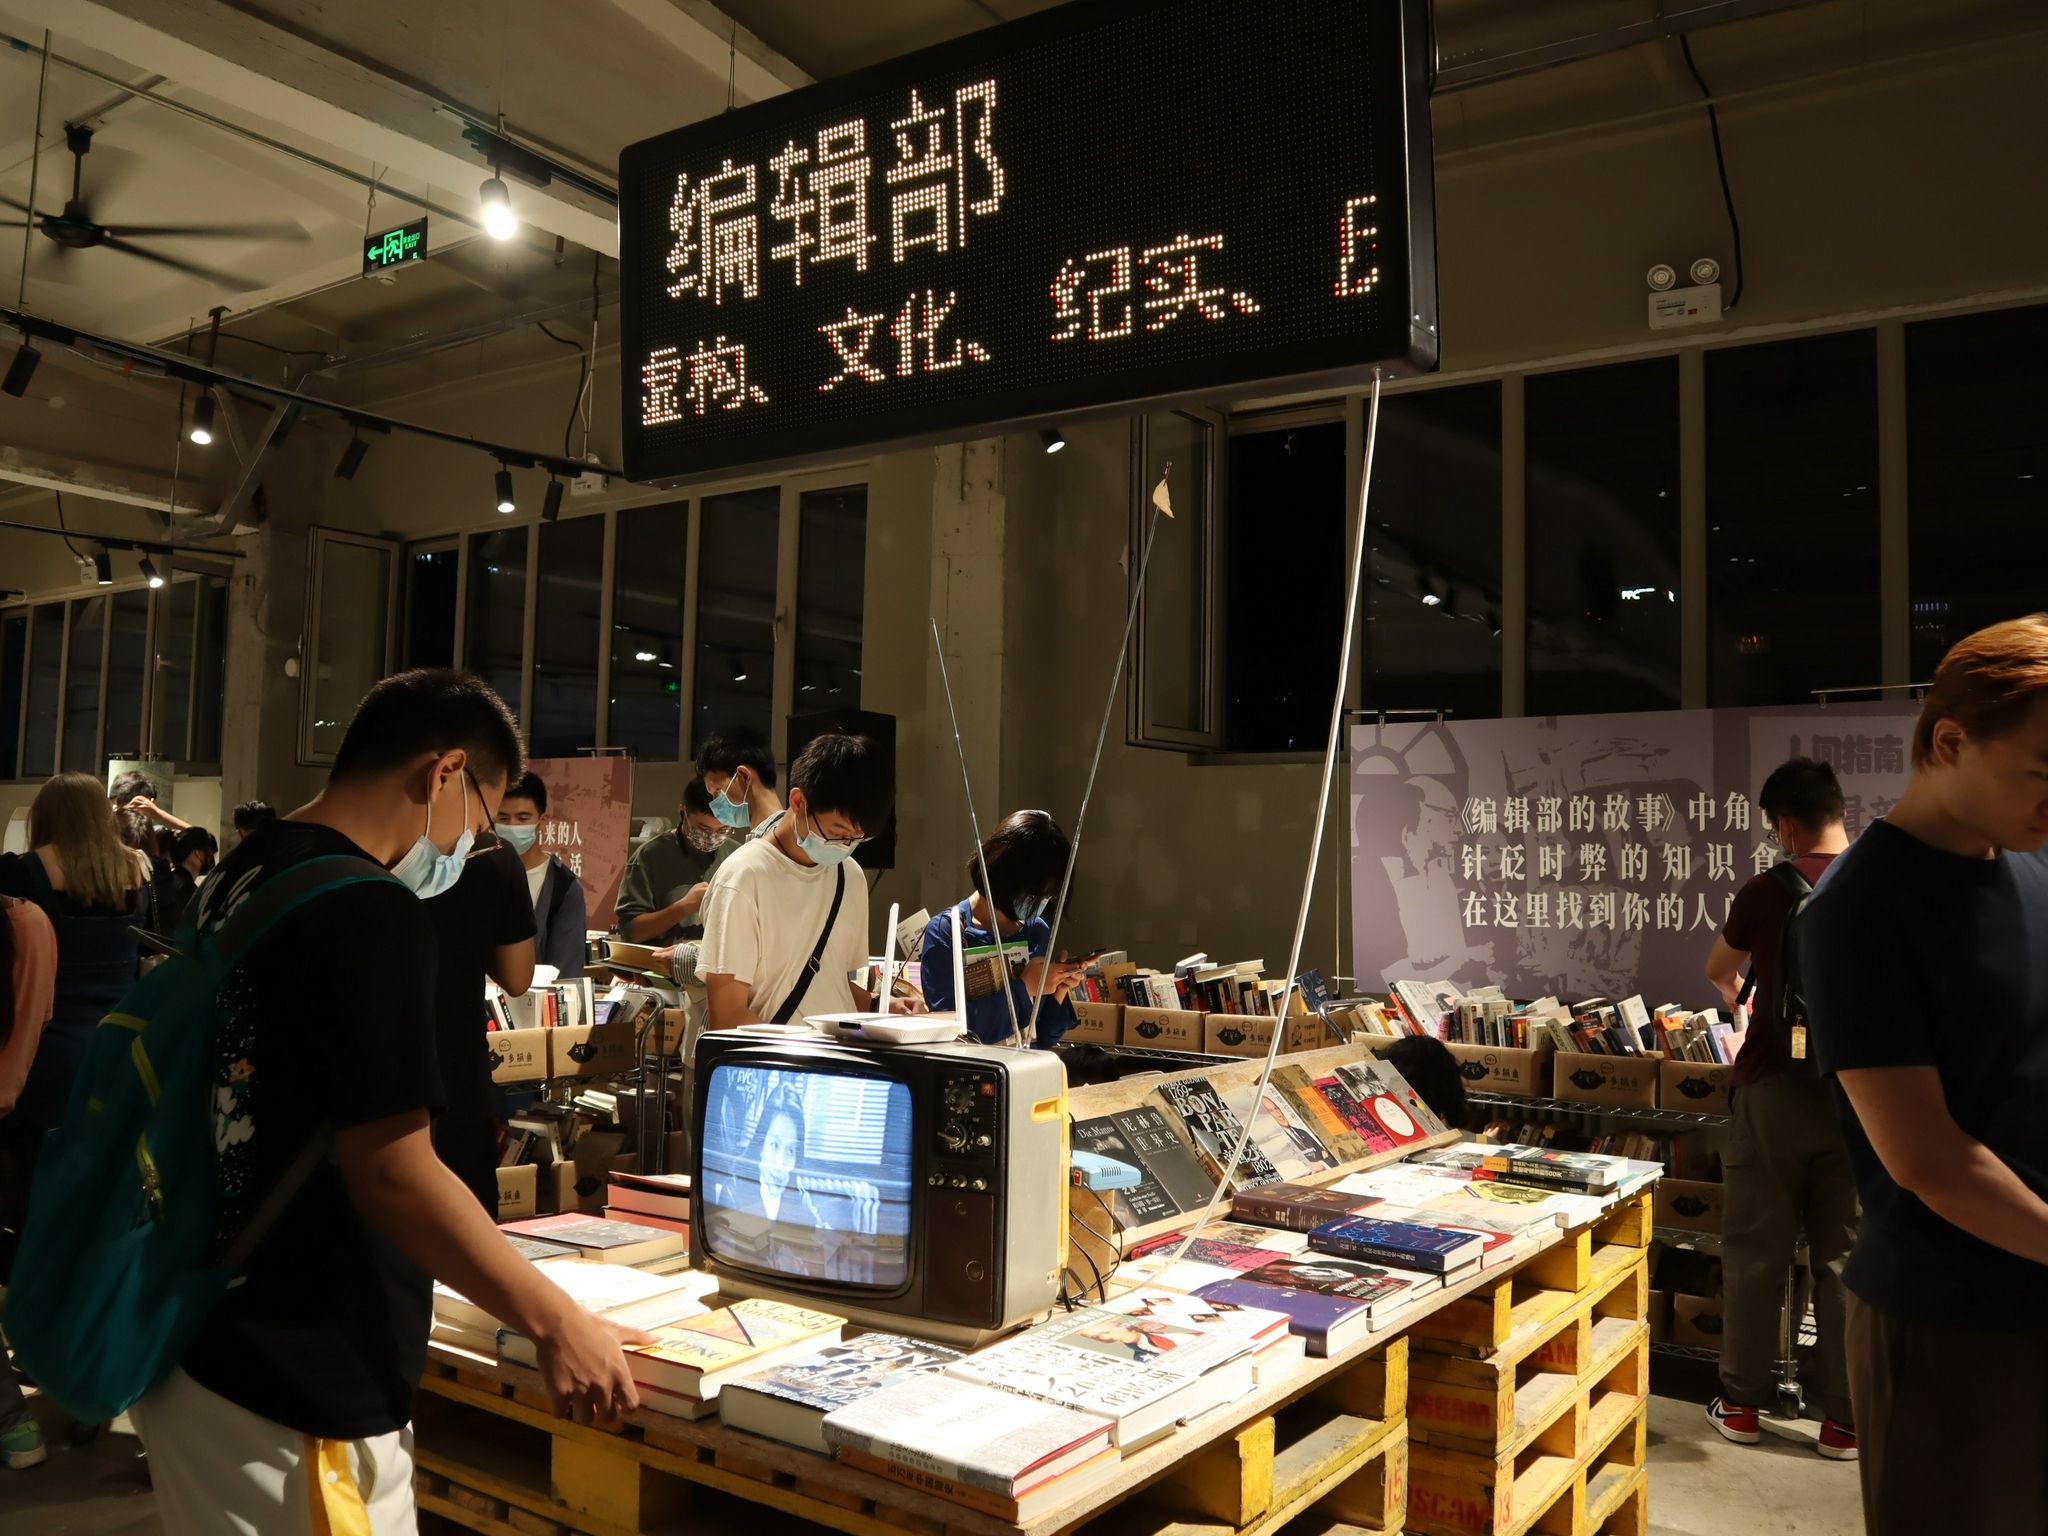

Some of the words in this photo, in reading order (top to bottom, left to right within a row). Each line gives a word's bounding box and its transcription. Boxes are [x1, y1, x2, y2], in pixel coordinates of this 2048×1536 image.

[666, 79, 1006, 305] 编辑部
[817, 288, 991, 391] 文化、
[1049, 233, 1262, 341] 纪实、
[1135, 1130, 1180, 1152] 世界史
